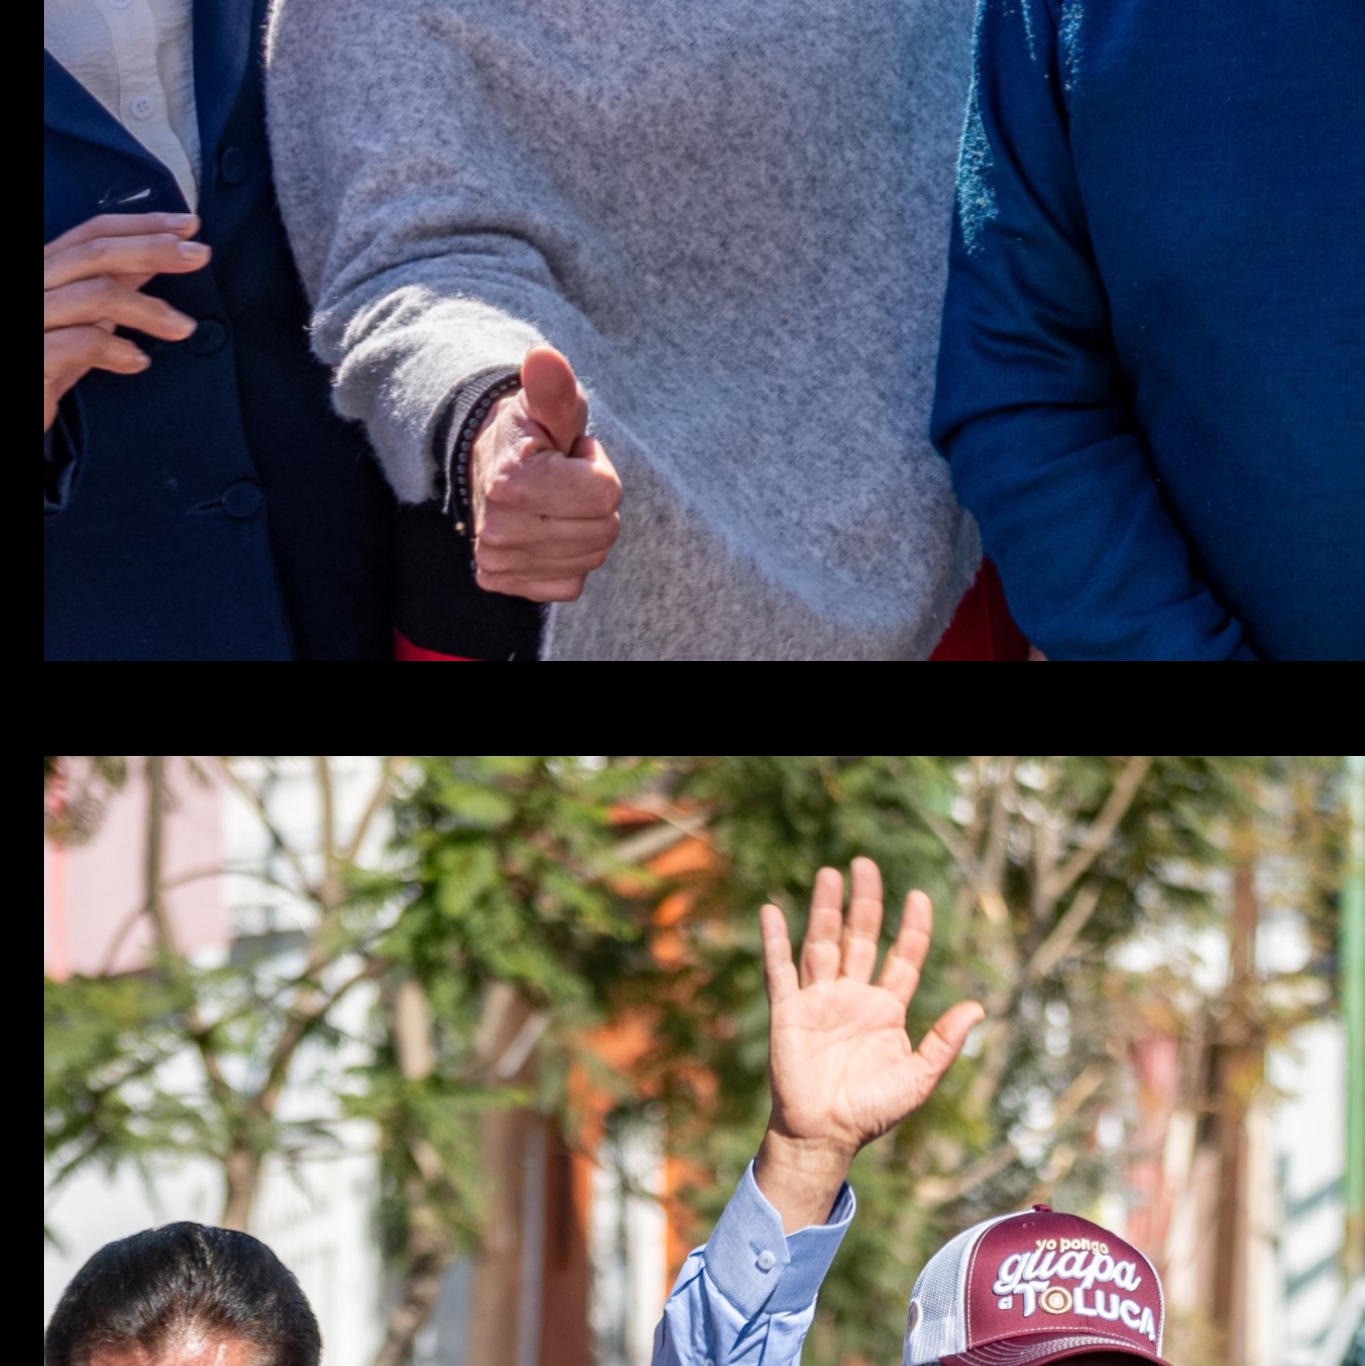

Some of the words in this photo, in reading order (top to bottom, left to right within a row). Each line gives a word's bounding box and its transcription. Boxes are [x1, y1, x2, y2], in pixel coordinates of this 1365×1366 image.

[1035, 1238, 1057, 1254] yo
[1059, 1237, 1110, 1256] pongo
[992, 1249, 1142, 1295] guapa
[1012, 1281, 1157, 1343] TOLUCA
